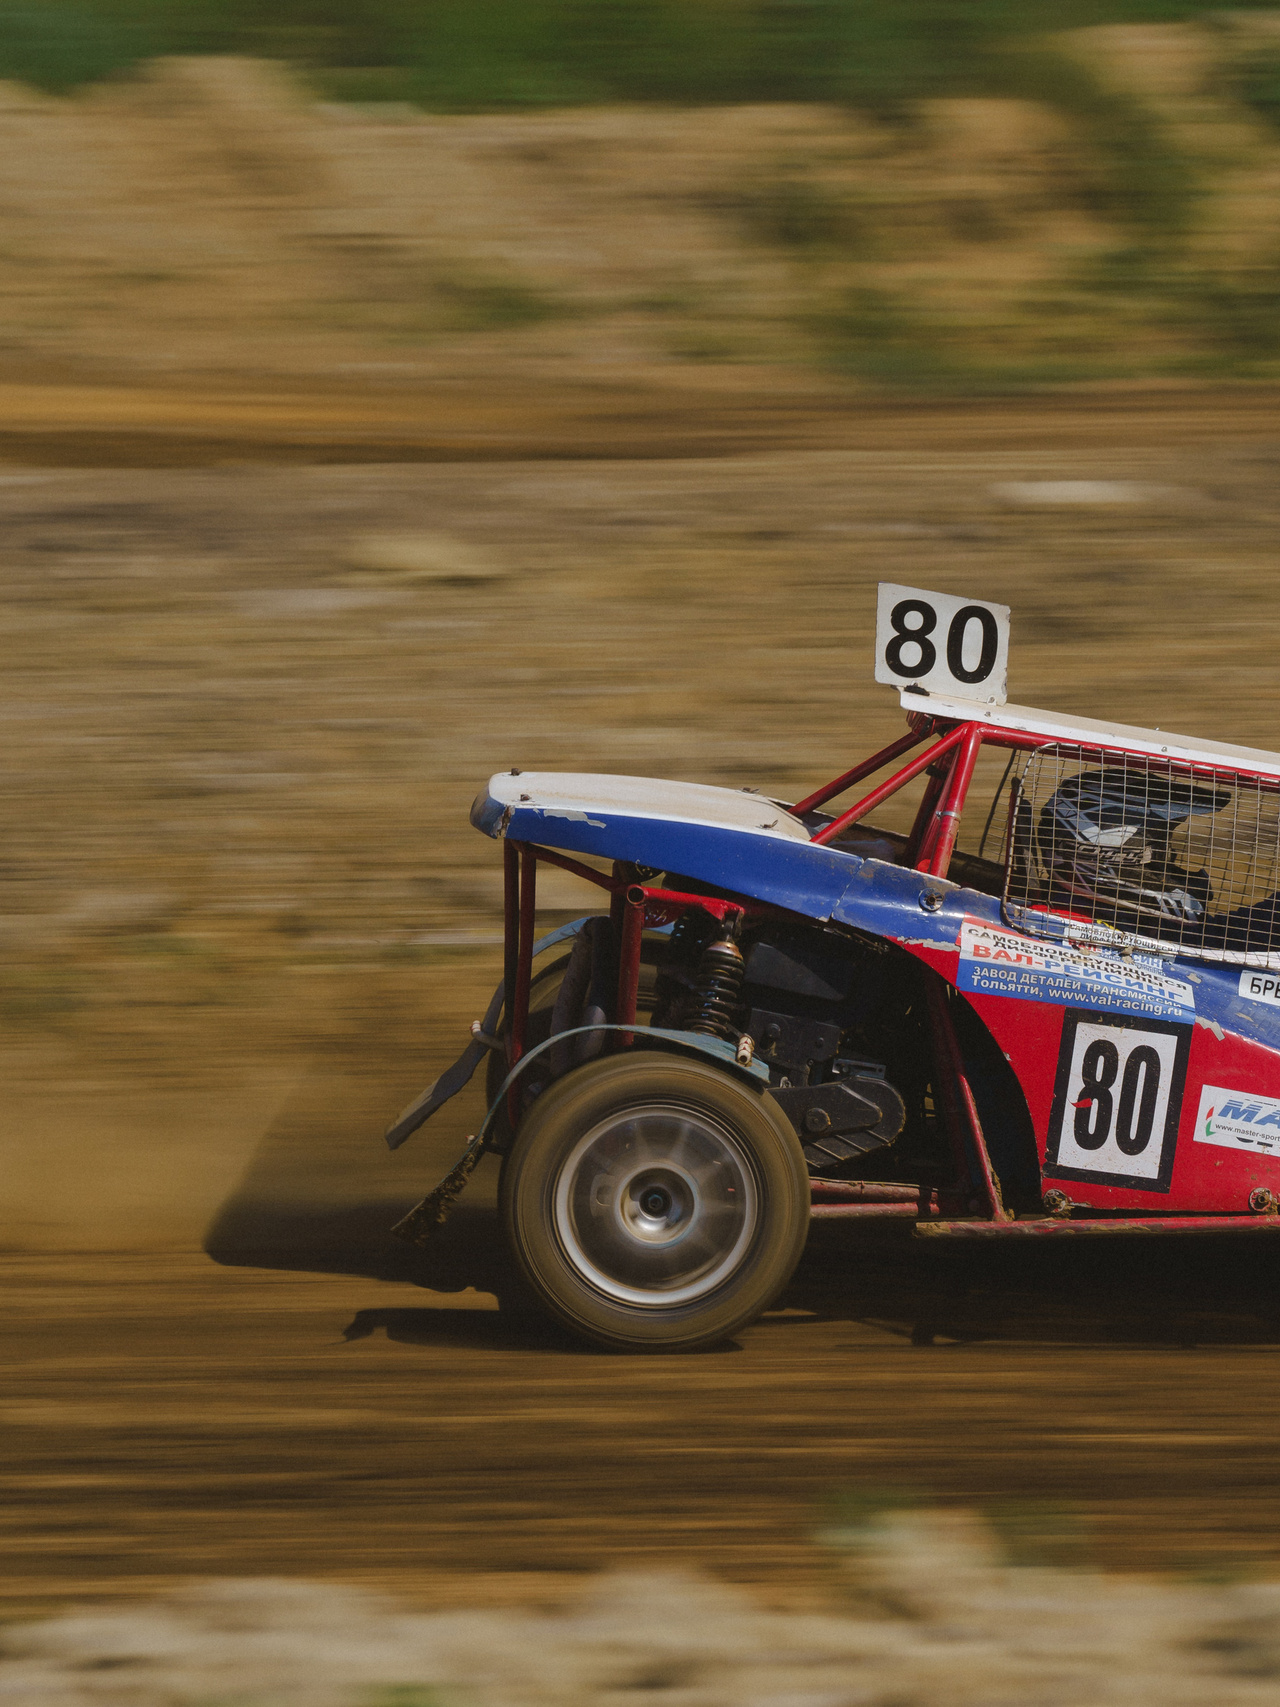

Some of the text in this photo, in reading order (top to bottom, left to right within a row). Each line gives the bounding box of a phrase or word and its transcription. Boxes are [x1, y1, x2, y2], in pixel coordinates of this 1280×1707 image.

[886, 599, 998, 684] 80
[968, 928, 1187, 991] САМОБЛОКИРУЮЩИЕСЯ
[973, 966, 1182, 1007] ЗАВОД ДЕТАЛЕЙ ТРАНСМИССИИ
[993, 941, 1163, 987] ДИФФЕРЕНЦИАЛЫ
[971, 975, 1183, 1016] Тольятти, www.val-racing.ru
[1073, 1039, 1162, 1156] 80
